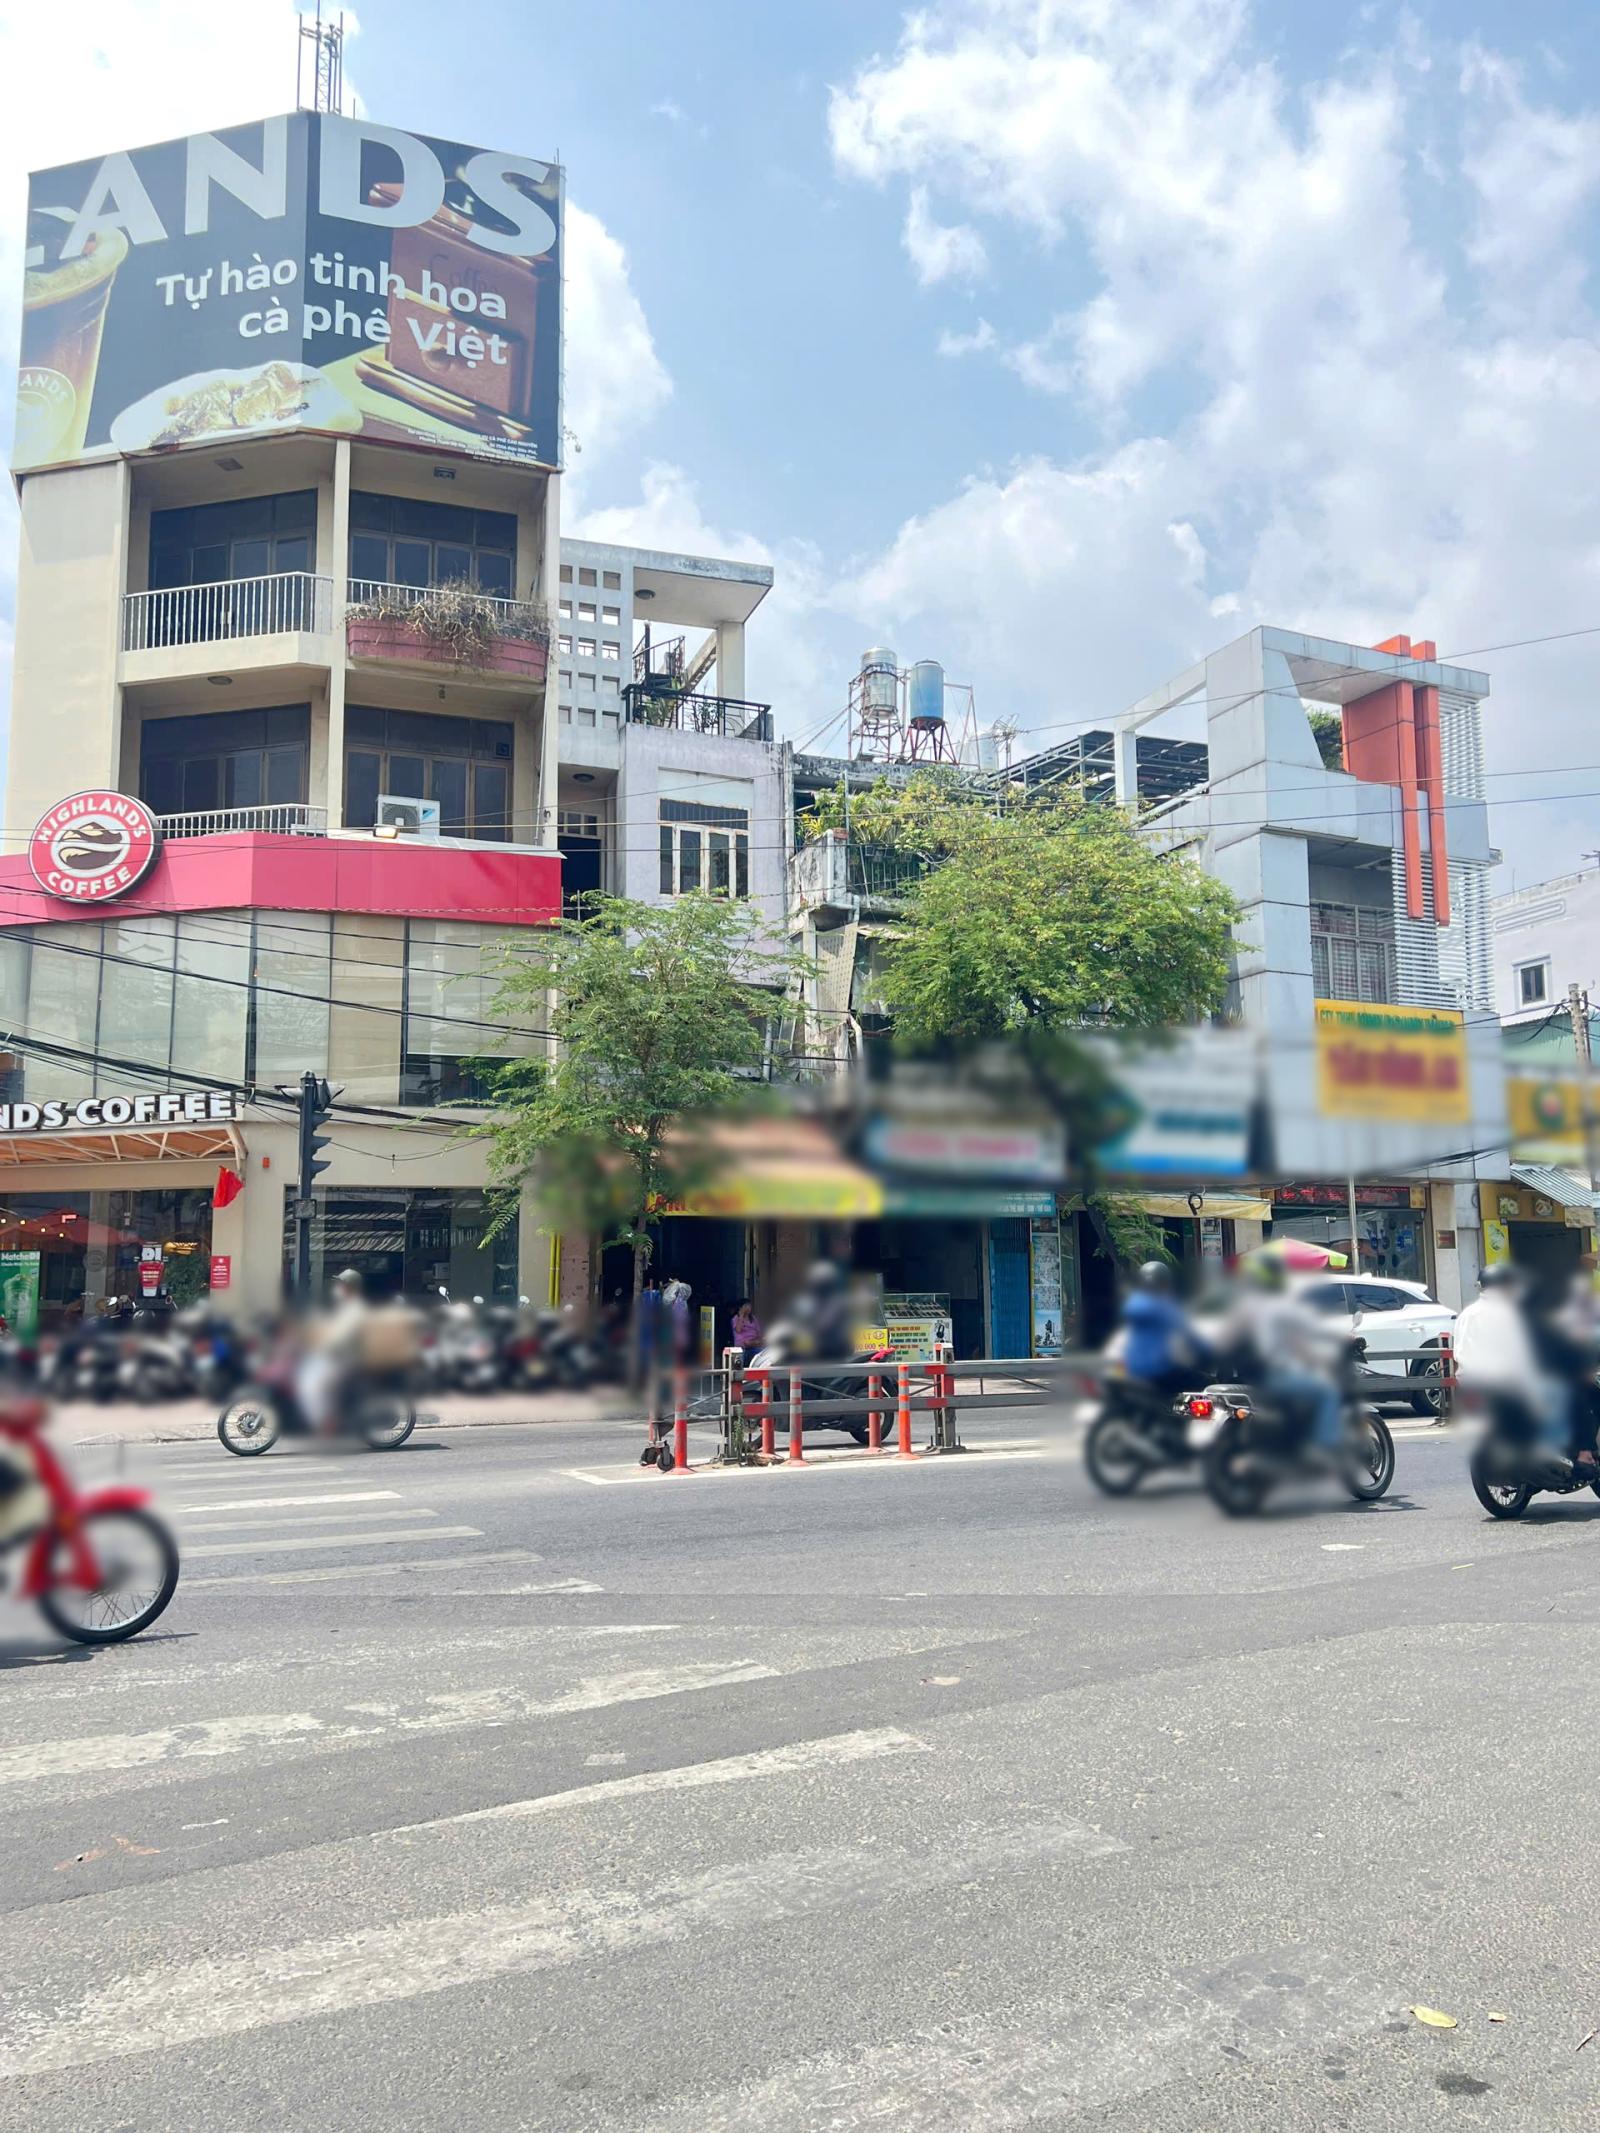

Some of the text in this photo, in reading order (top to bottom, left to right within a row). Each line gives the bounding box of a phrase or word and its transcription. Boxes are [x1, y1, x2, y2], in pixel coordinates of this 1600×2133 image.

[155, 252, 507, 320] Tự hào tinh hoa
[238, 296, 509, 369] cà phê Việt
[37, 798, 147, 844] HIGHLANDS
[47, 866, 132, 895] COFFEE
[75, 1090, 234, 1126] COFFEE
